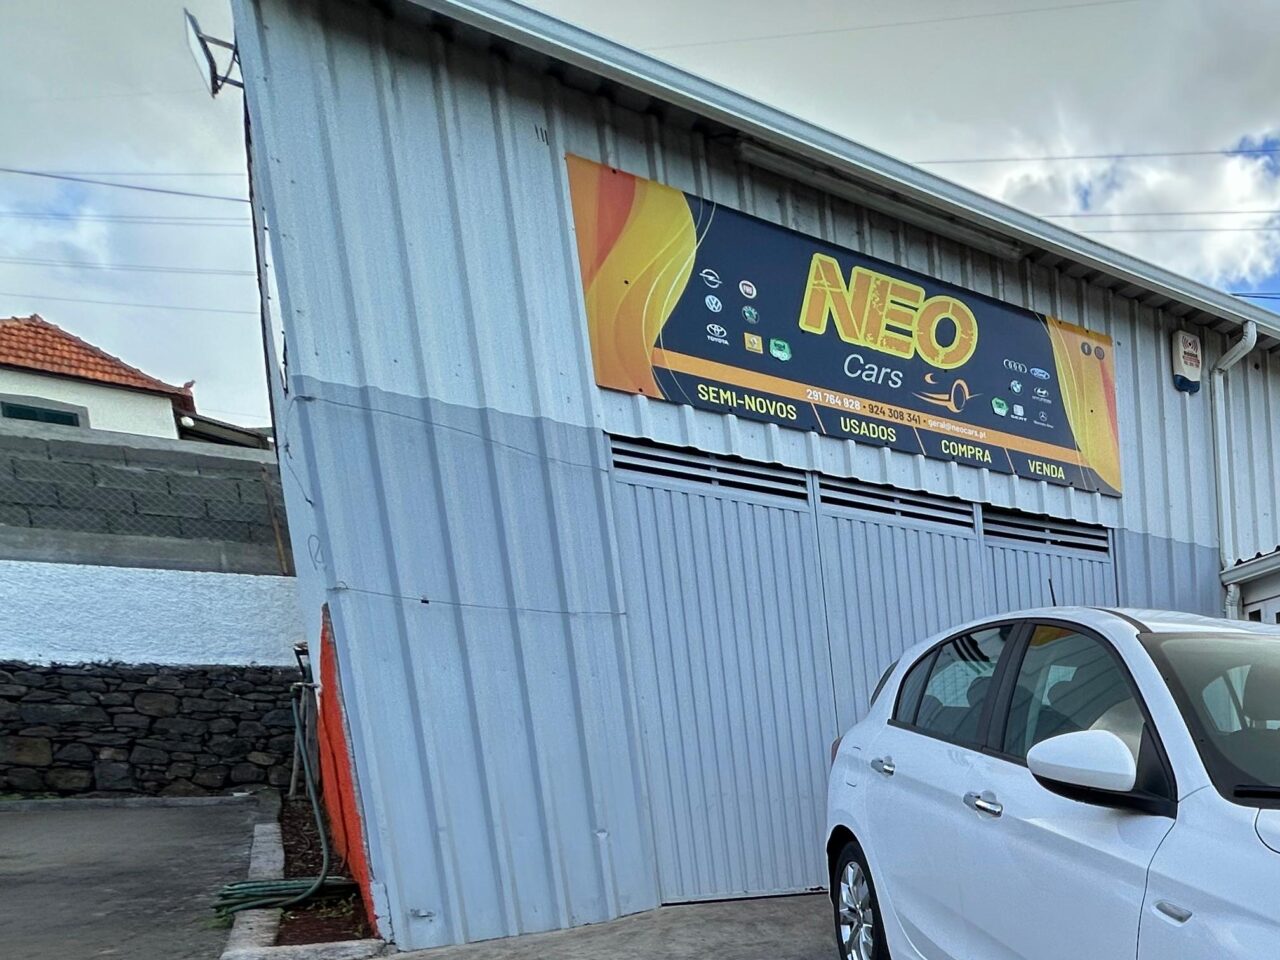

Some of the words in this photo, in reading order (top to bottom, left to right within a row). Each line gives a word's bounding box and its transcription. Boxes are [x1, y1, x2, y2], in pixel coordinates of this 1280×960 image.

[798, 252, 978, 369] NEO
[843, 354, 903, 388] Cars
[697, 384, 797, 420] SEMI-NOVOS
[806, 389, 822, 401] 291
[824, 393, 842, 406] 764
[843, 397, 861, 410] 928
[868, 404, 885, 416] 924
[888, 408, 904, 421] 308
[907, 412, 921, 425] 341
[928, 419, 987, 439] geral@neocars.pt
[840, 417, 896, 442] USADOS
[941, 440, 992, 464] COMPRA
[1028, 460, 1065, 480] VENDA
